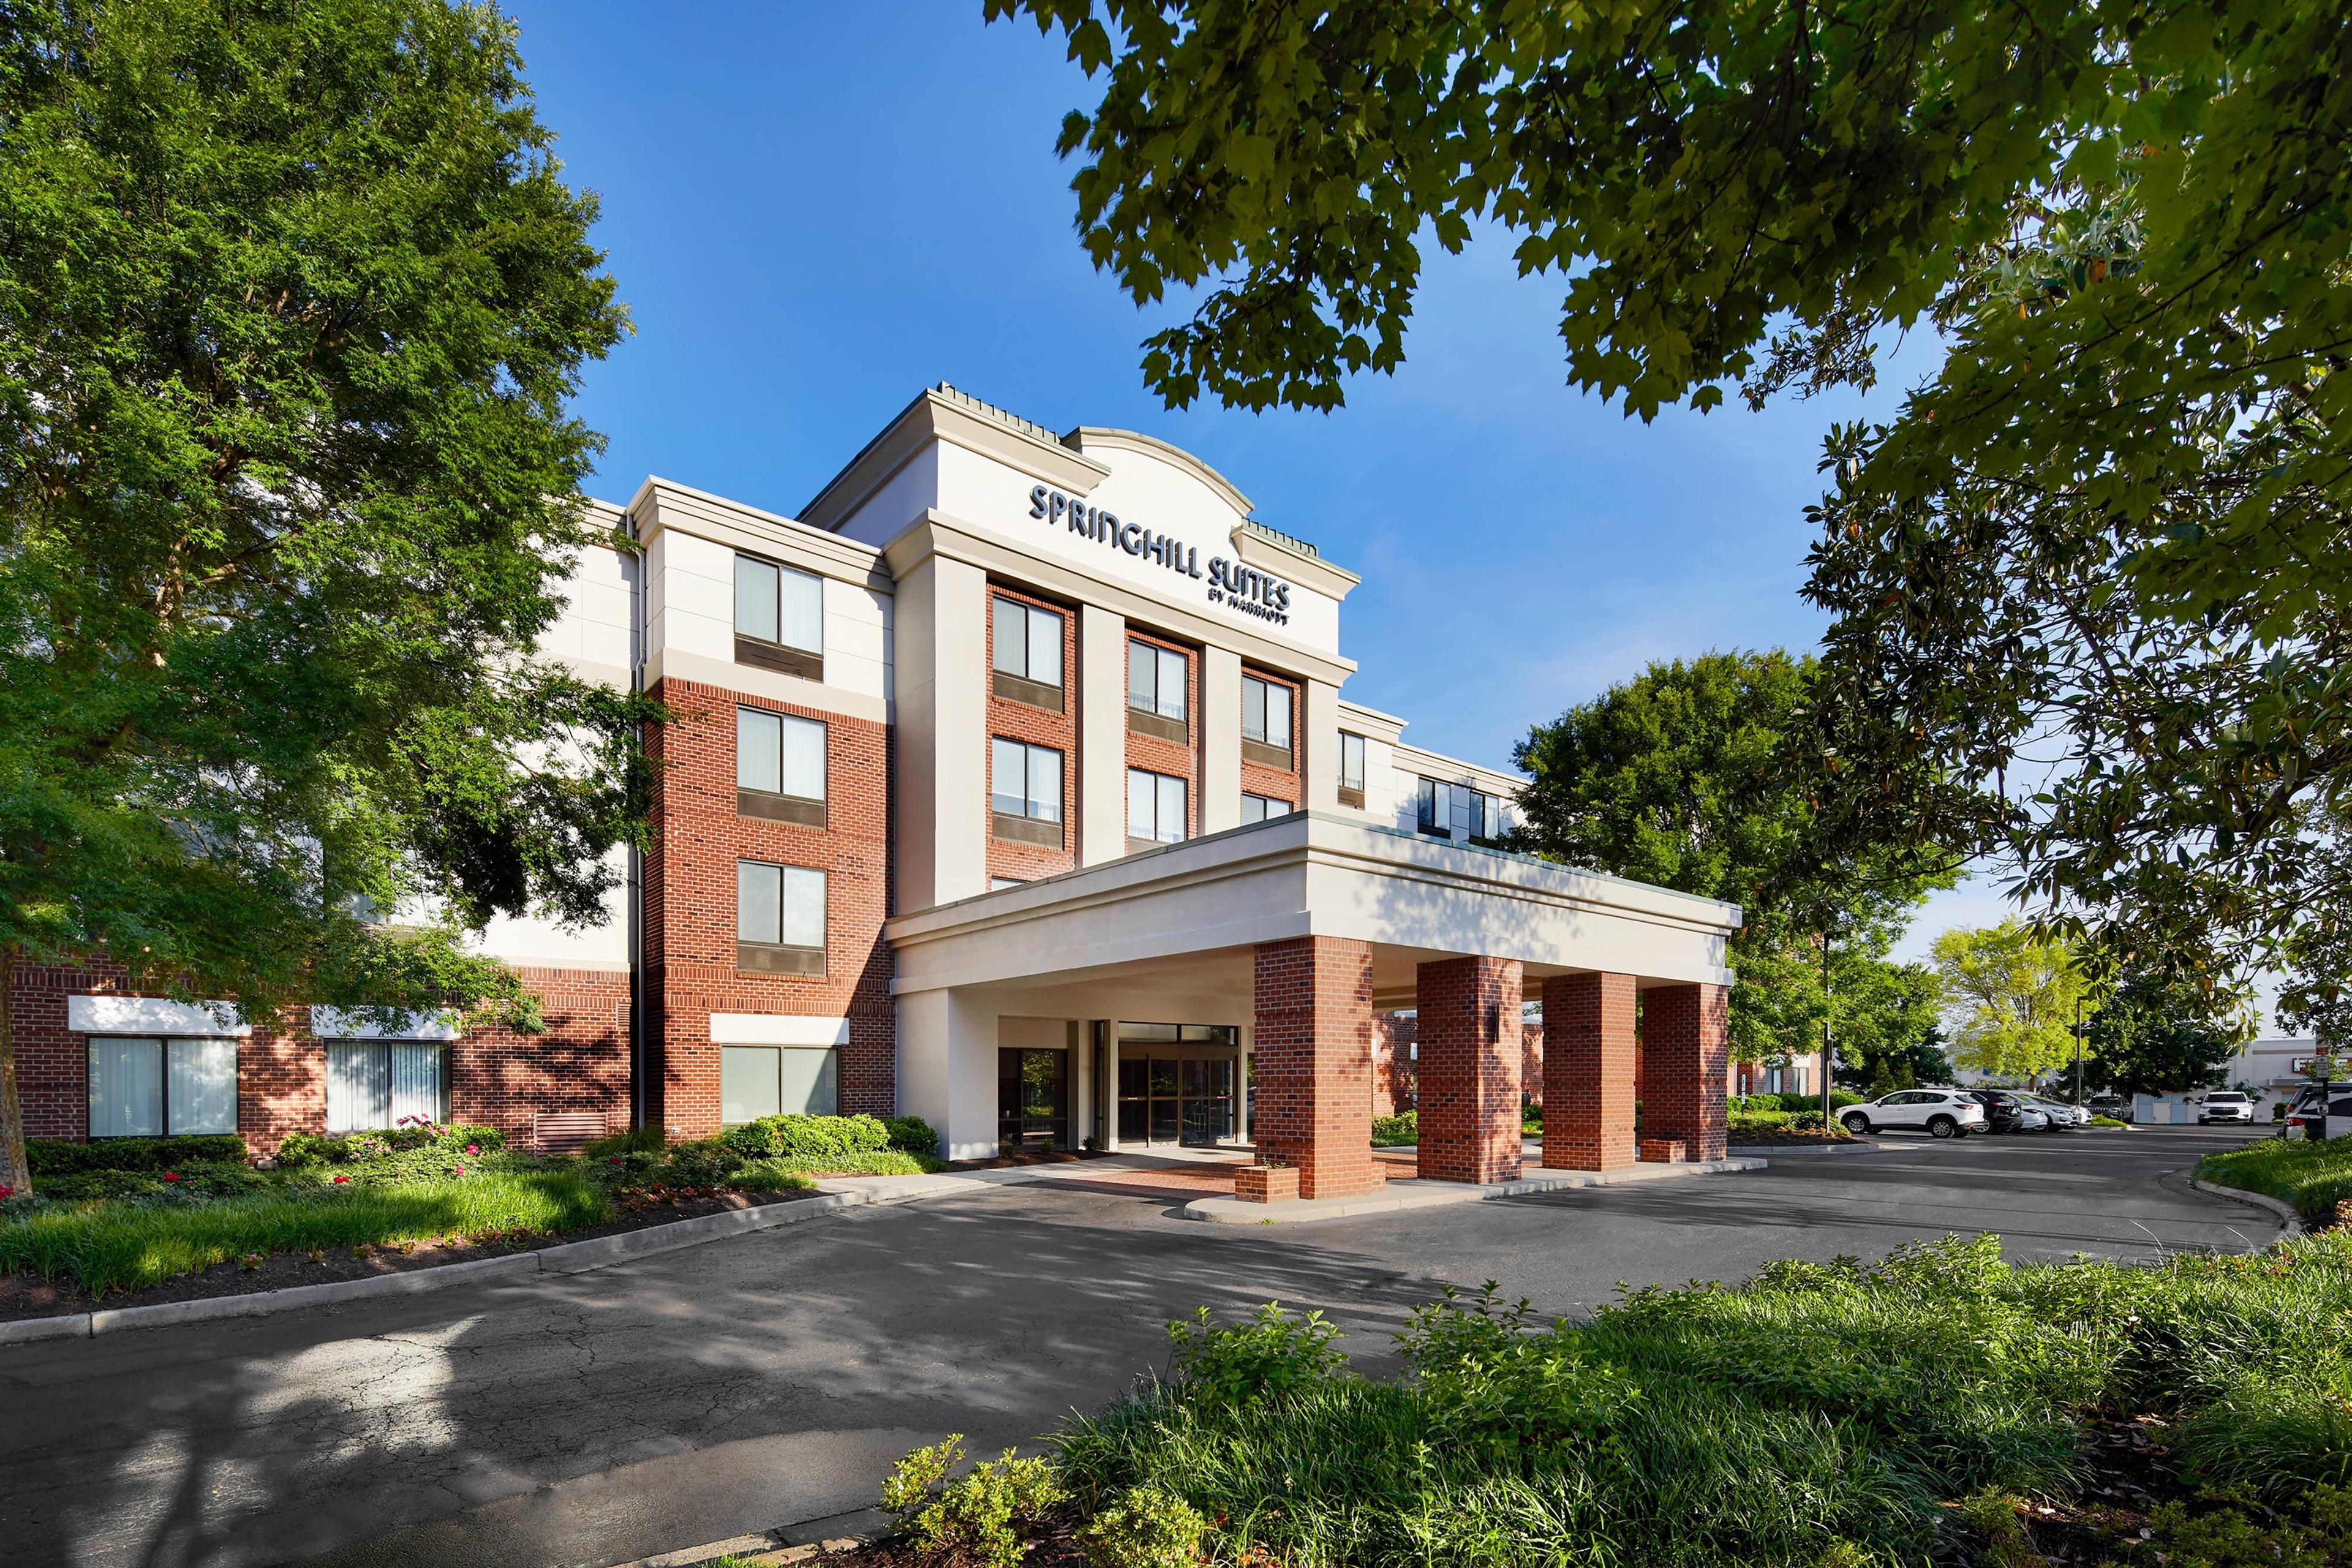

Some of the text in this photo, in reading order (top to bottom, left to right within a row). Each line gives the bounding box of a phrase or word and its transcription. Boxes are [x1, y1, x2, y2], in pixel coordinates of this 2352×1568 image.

[1029, 484, 1290, 611] SPRINGHILL SUITES
[1208, 587, 1290, 627] BY MARRIOTT
